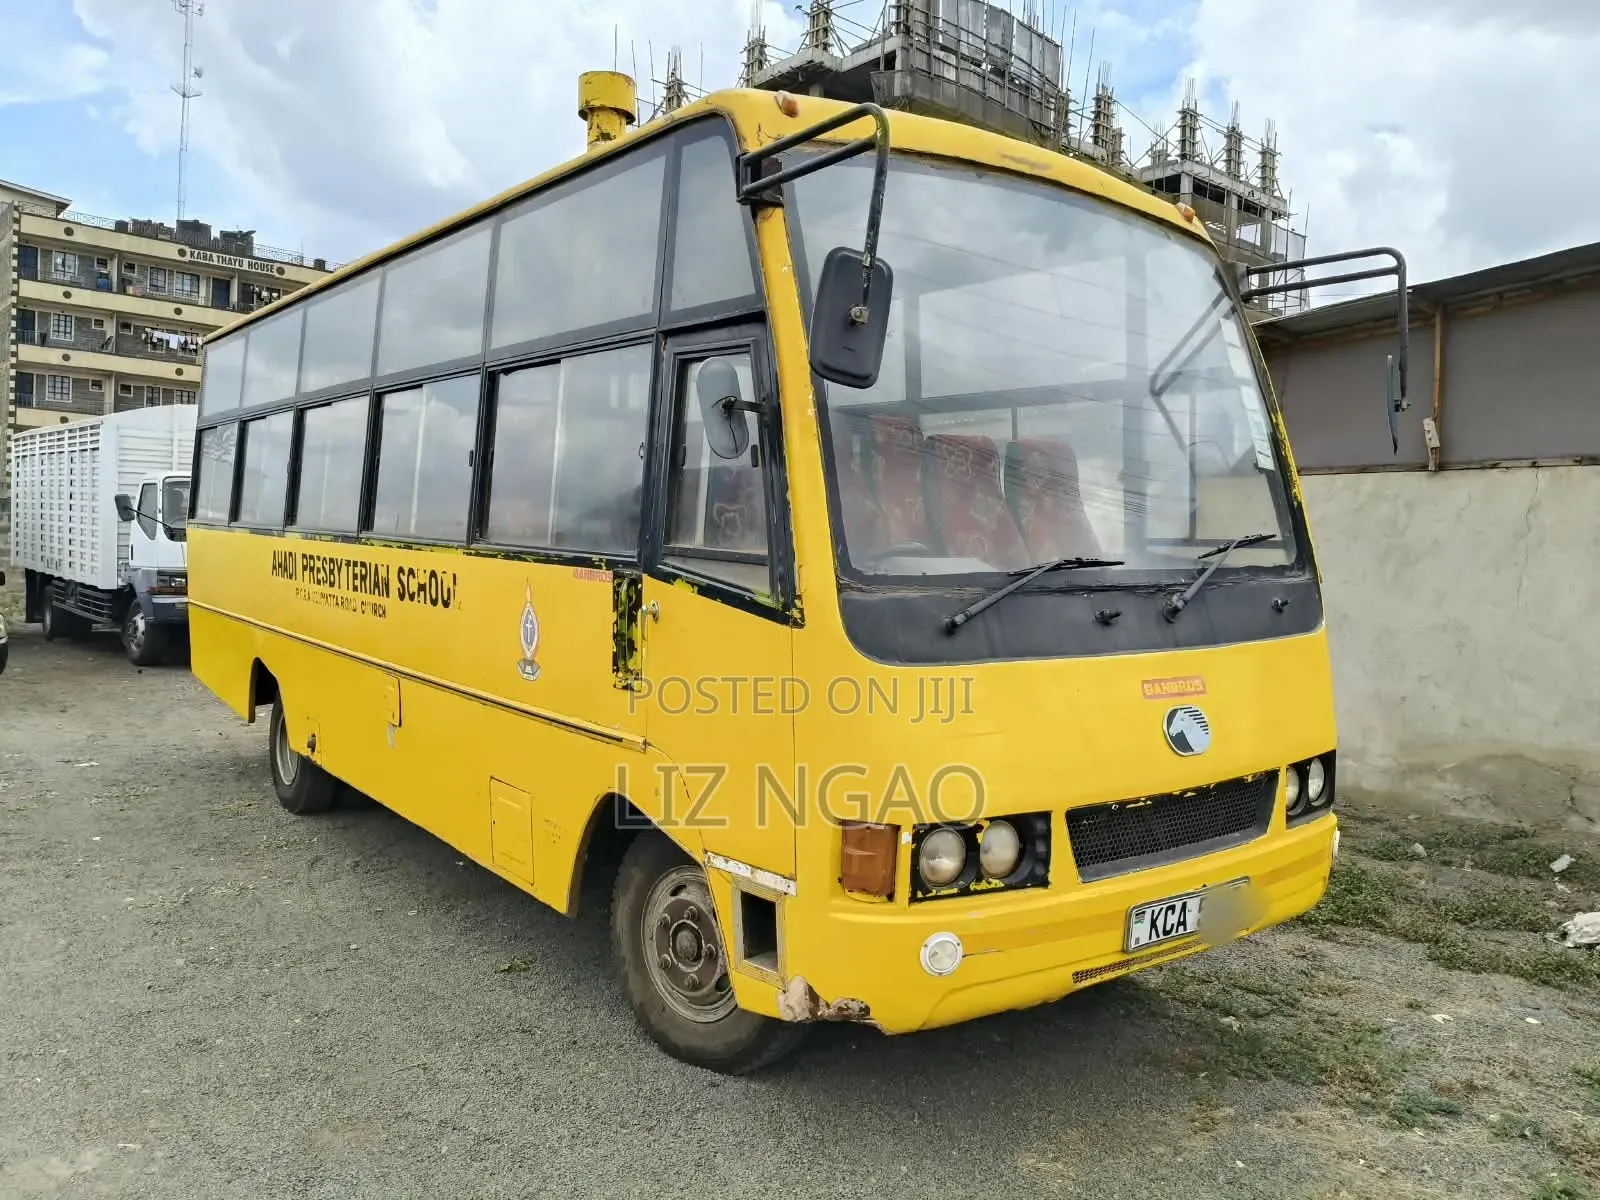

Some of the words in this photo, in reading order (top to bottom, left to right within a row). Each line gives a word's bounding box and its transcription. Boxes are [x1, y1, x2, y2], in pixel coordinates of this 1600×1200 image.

[189, 250, 214, 263] KABA
[216, 254, 244, 268] THAYU
[247, 261, 275, 273] HOUSE
[271, 549, 297, 582] AHADI
[301, 553, 390, 599] PRESBYTERIAN
[360, 600, 386, 618] CRCH
[1148, 901, 1188, 941] KCA
